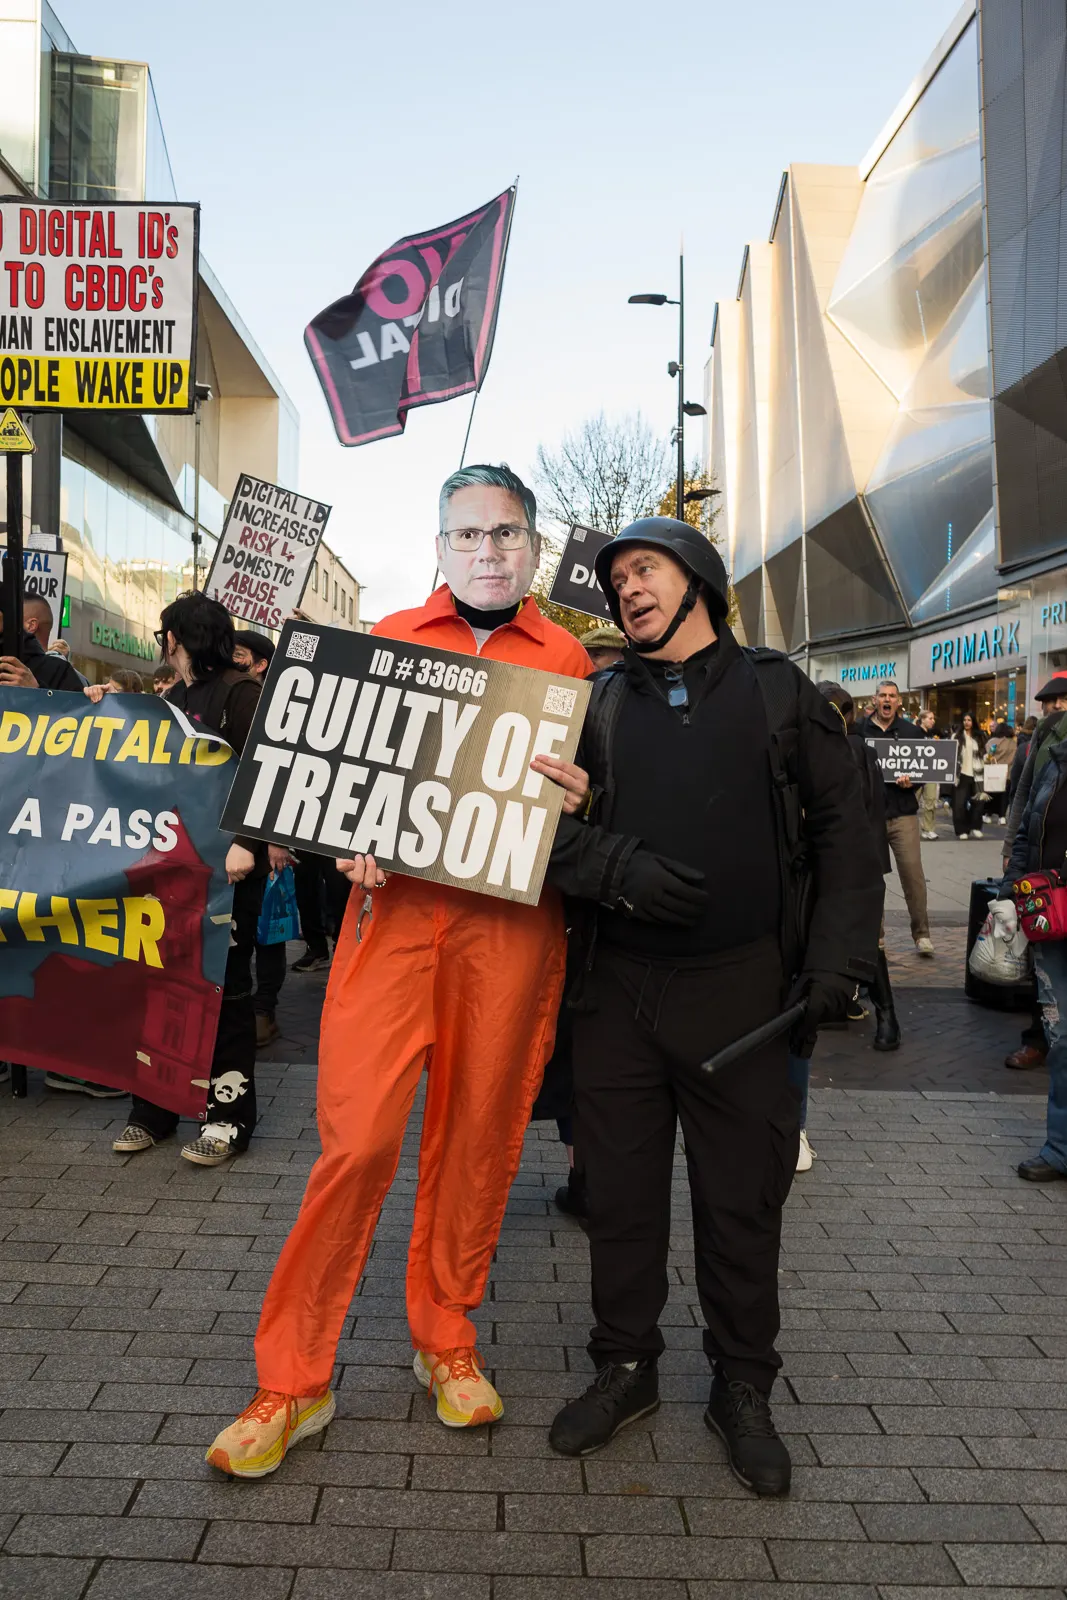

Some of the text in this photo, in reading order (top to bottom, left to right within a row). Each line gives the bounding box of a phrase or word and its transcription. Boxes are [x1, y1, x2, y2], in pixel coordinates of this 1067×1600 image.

[20, 208, 122, 258] DIGITAL
[138, 212, 179, 259] ID's
[4, 261, 164, 312] TO CBDC's
[44, 316, 176, 354] ENSLAVEMENT
[75, 360, 144, 404] WAKE
[153, 362, 183, 405] UP
[232, 500, 320, 547] INCREASES
[238, 525, 280, 557] RISK
[222, 544, 295, 587] DOMESTIC
[569, 563, 604, 593] DI
[214, 588, 283, 630] VICTIMS
[223, 571, 279, 607] ABUSE
[930, 620, 1020, 672] PRIMARK
[369, 648, 394, 677] ID
[416, 658, 488, 698] 33666
[840, 662, 897, 682] PRIMARK
[0, 711, 233, 767] DIGITAL ID
[264, 665, 569, 799] GUILTY OF
[888, 745, 936, 758] NO TO
[932, 758, 949, 771] ID
[8, 798, 179, 853] A PASS
[242, 743, 548, 892] TREASON
